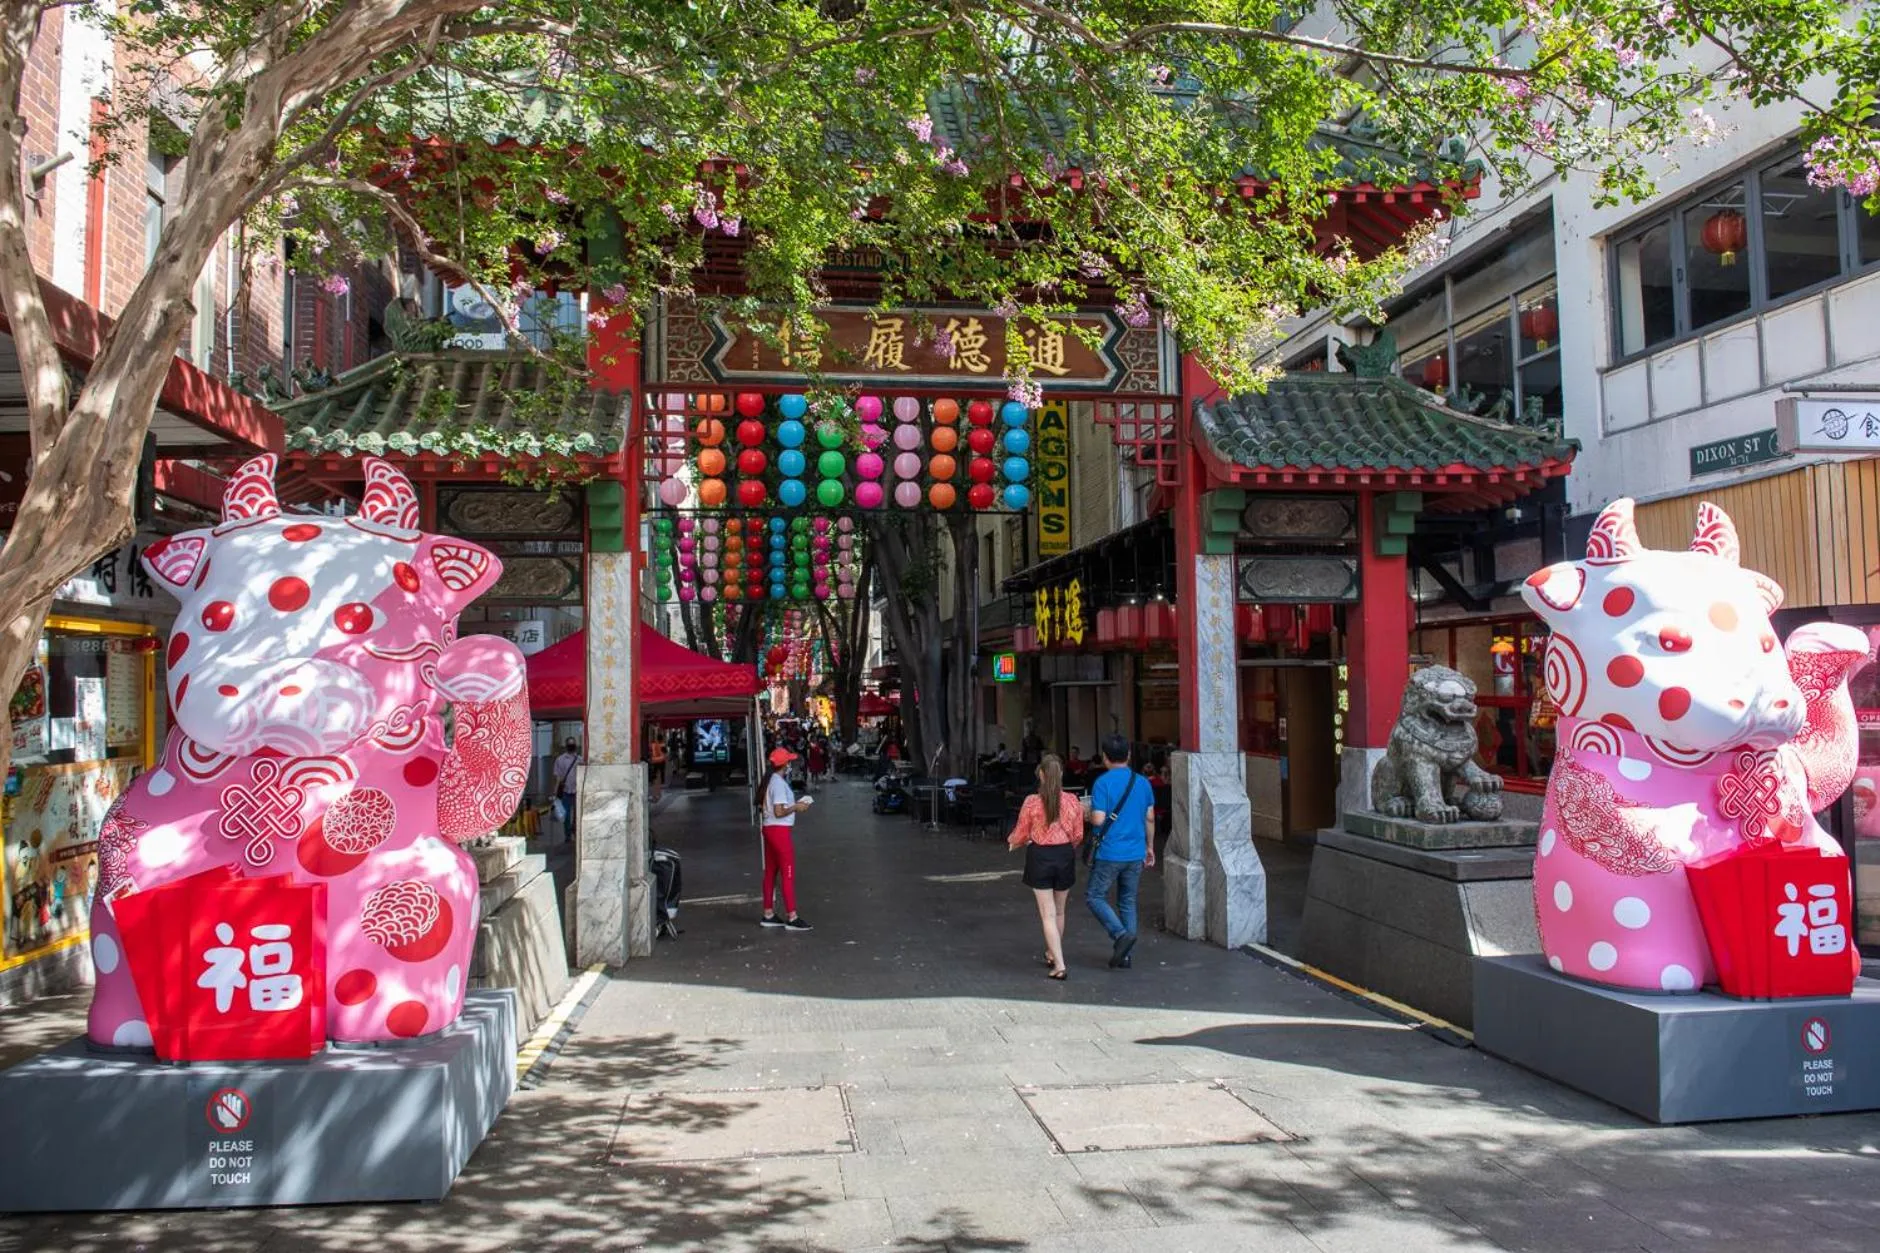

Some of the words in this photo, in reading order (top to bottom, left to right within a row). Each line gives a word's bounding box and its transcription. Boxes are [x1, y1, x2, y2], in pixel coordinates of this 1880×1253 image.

[826, 252, 882, 267] ERSTAND
[448, 338, 485, 351] OOD
[1696, 442, 1737, 465] DIXON
[1744, 437, 1761, 454] ST
[1040, 400, 1066, 534] AGONS
[1774, 882, 1846, 957] 福
[196, 922, 303, 1014] 福
[1803, 1059, 1834, 1070] PLEASE
[1804, 1073, 1816, 1083] DO
[1817, 1072, 1833, 1082] NOT
[1805, 1085, 1833, 1096] TOUCH
[209, 1140, 254, 1152] PLEASE
[209, 1157, 227, 1169] DO
[229, 1156, 253, 1168] NOT
[210, 1172, 251, 1185] TOUCH
